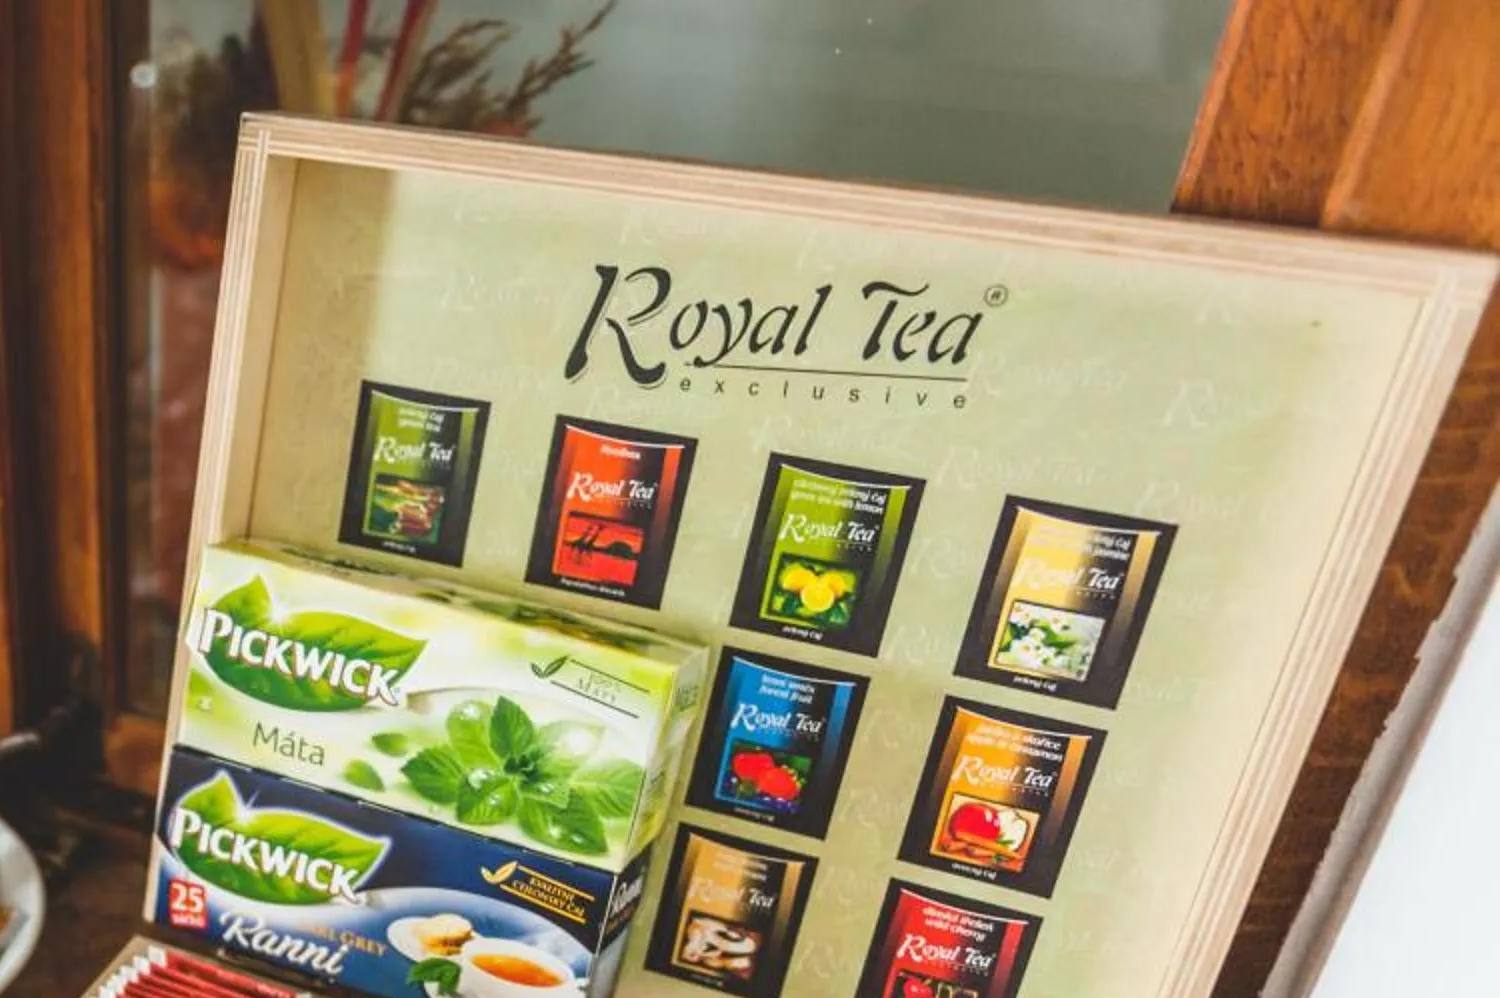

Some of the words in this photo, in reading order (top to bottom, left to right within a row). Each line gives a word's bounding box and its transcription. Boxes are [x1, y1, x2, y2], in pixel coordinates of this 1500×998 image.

[565, 264, 833, 389] Royal
[680, 376, 967, 409] exclusive
[373, 434, 425, 464] Royal
[428, 441, 454, 462] Tea
[566, 471, 625, 501] Royal
[628, 479, 655, 500] Tea
[779, 513, 843, 544] Royal
[847, 521, 876, 543] Tea
[1088, 567, 1120, 590] Tea
[201, 606, 400, 707] PICKWICK
[730, 702, 792, 732] Royal
[795, 712, 823, 733] Tea
[251, 719, 327, 768] Máta
[950, 754, 1020, 785] Royal
[1023, 766, 1054, 787] Tea
[170, 806, 362, 906] PICKWICK
[169, 881, 205, 913] 25
[749, 888, 774, 908] Tea
[896, 932, 961, 963] Royal
[965, 947, 993, 968] Tea
